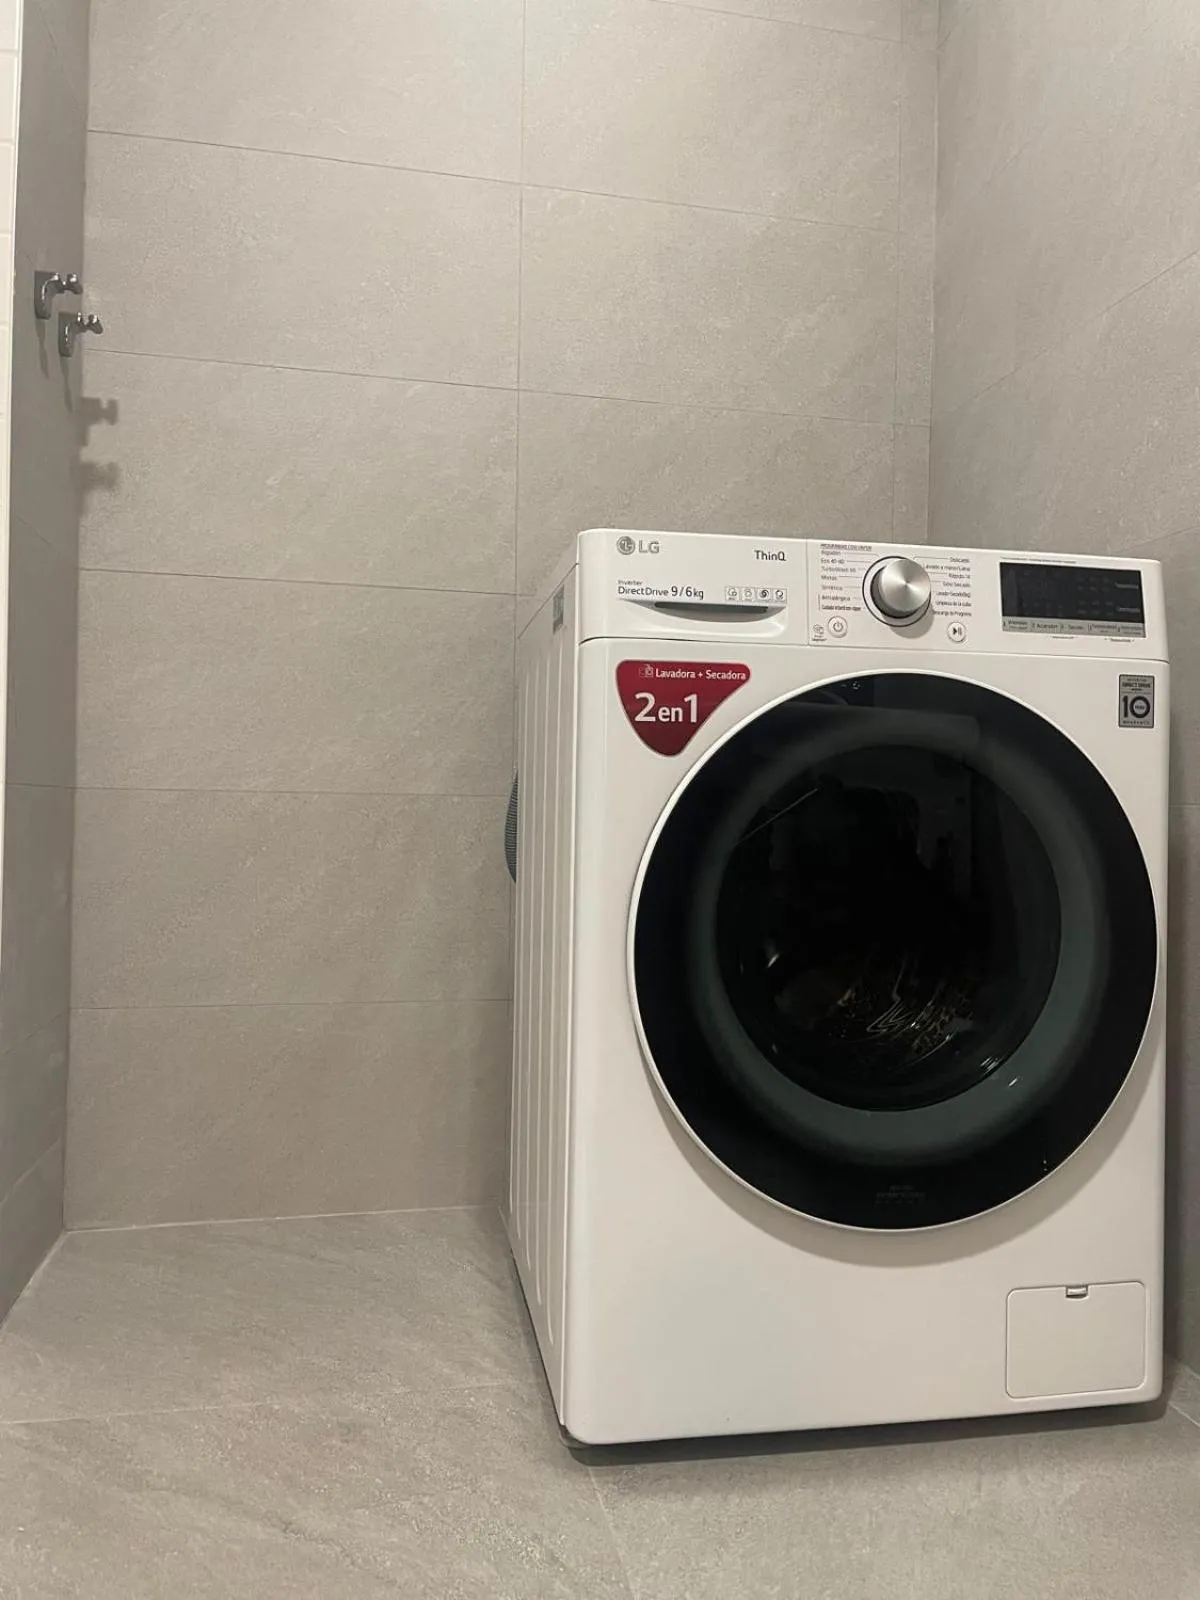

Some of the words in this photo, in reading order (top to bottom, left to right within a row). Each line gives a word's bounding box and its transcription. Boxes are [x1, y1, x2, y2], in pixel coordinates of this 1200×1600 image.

[638, 539, 660, 554] LG
[754, 550, 787, 561] ThinQ
[655, 668, 696, 679] Lavadora
[705, 669, 746, 680] Secadora
[1123, 695, 1151, 719] 10
